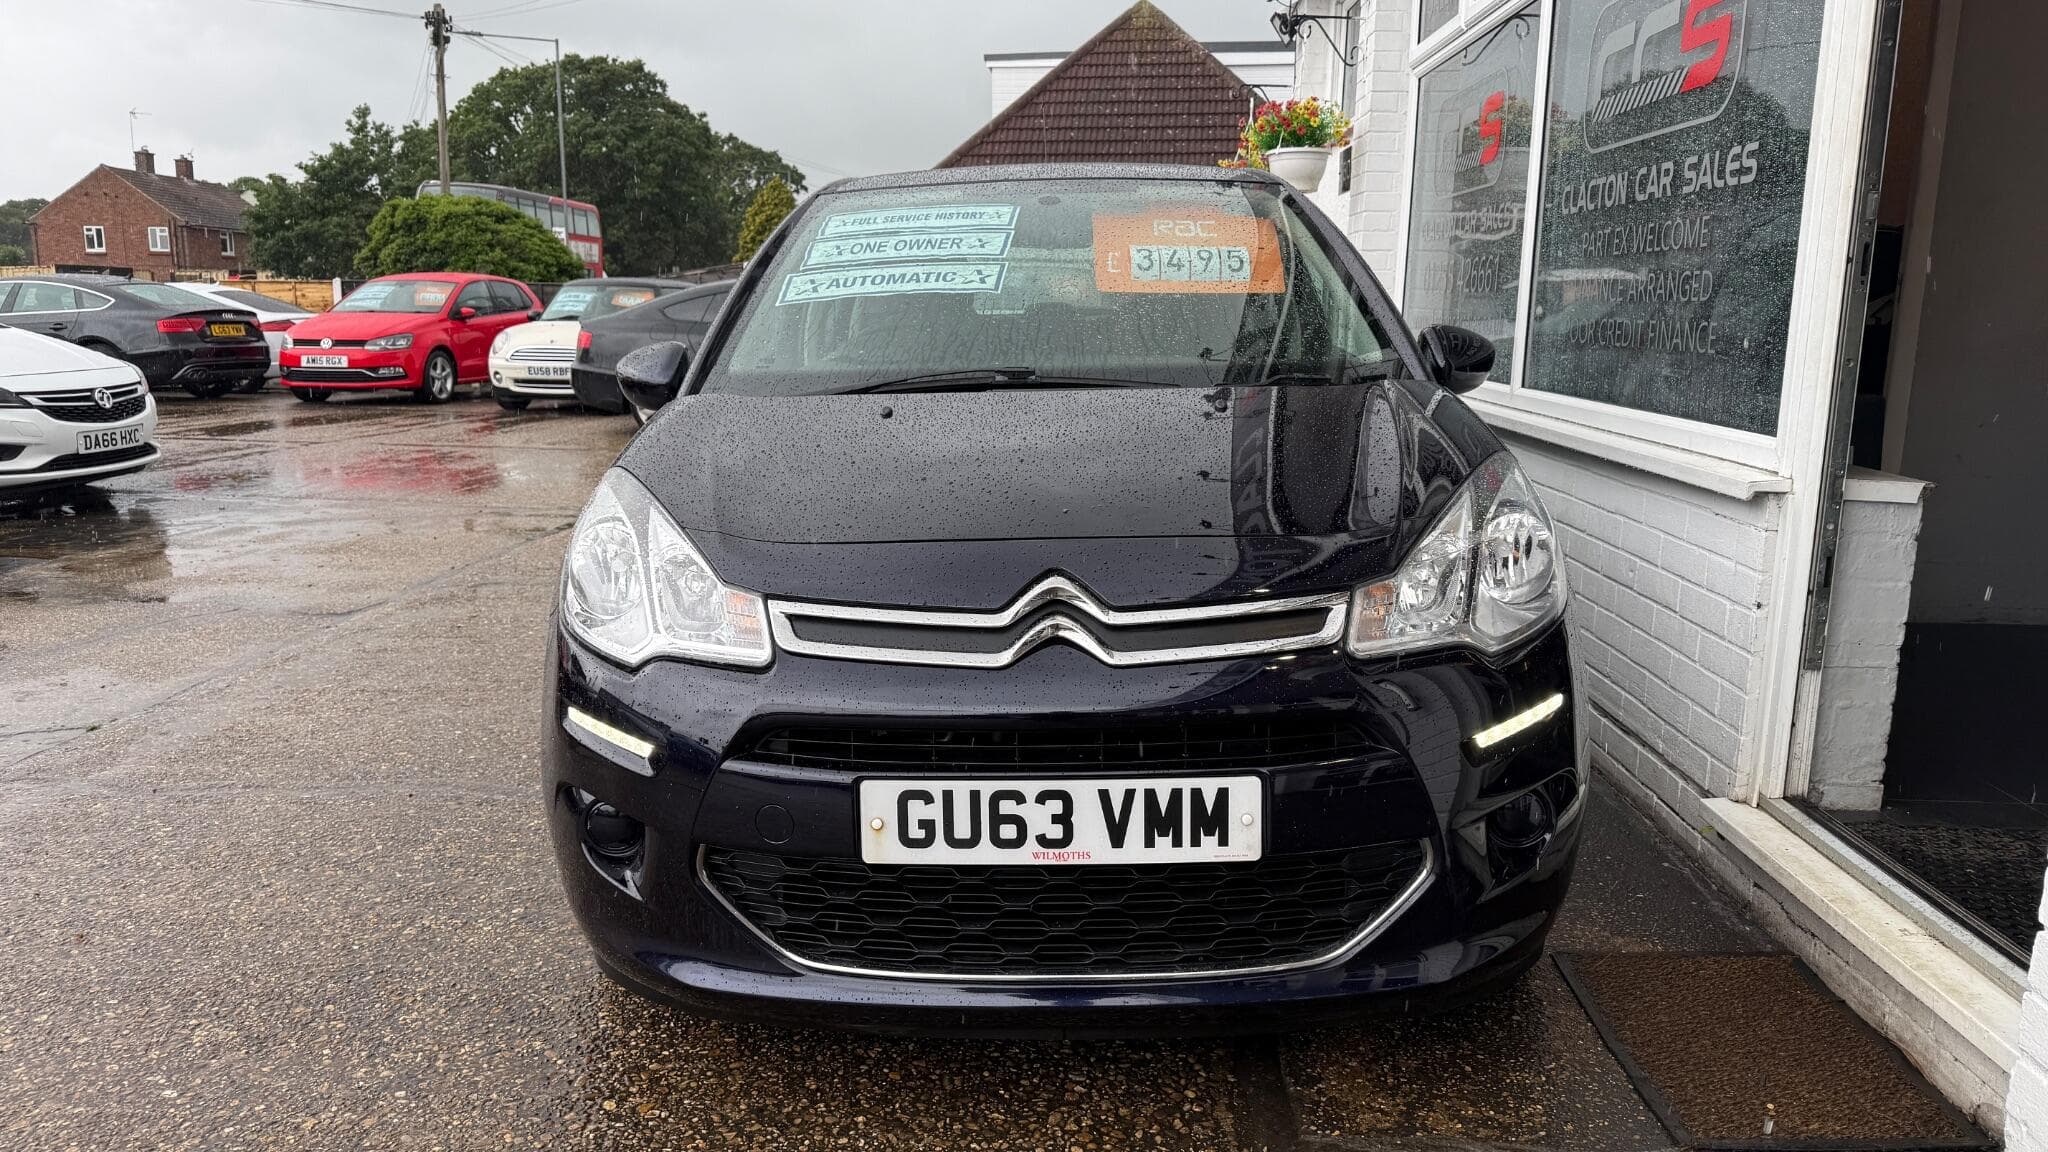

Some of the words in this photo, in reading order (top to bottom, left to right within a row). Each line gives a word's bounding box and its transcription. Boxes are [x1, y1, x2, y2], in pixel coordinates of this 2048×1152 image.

[1562, 171, 1629, 215] CLACTON
[1635, 161, 1674, 201] CAR
[1683, 141, 1760, 194] SALES
[850, 216, 878, 227] FULL
[882, 213, 931, 224] SERVICE
[934, 211, 986, 221] HISTORY
[850, 241, 889, 255] ONE
[893, 238, 963, 252] OWNER
[1583, 229, 1612, 257] PART
[1612, 226, 1632, 255] EX
[1632, 215, 1711, 253] WELCOME
[825, 271, 957, 290] AUTOMATIC
[1573, 270, 1624, 303] INANCE
[1627, 270, 1713, 303] ARRANGED
[1599, 318, 1645, 349] CREDIT
[1647, 319, 1718, 354] FINANCE
[325, 356, 343, 366] RGX
[527, 366, 551, 376] EU58
[553, 367, 570, 377] RBF
[83, 431, 118, 451] DA66
[120, 428, 140, 446] HXC
[897, 789, 1074, 850] GU63
[1097, 786, 1230, 849] VMM
[1031, 851, 1092, 861] WILMOTHS
